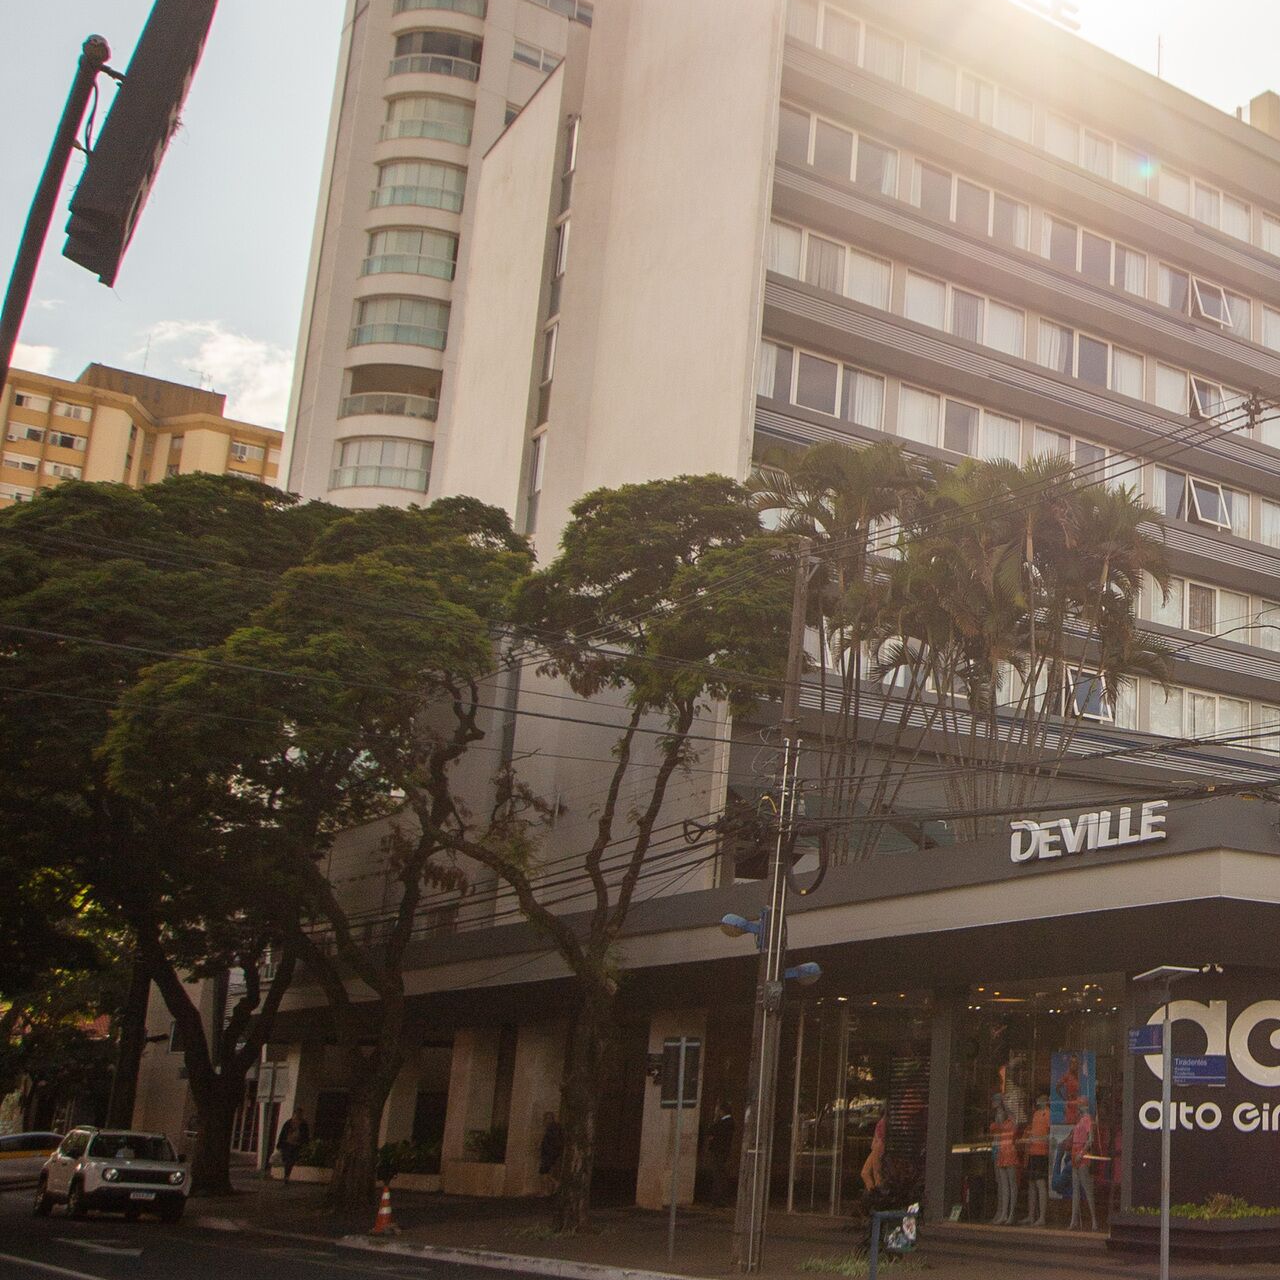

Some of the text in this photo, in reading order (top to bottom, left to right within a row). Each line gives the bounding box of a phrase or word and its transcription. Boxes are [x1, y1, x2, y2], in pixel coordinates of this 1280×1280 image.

[1010, 799, 1169, 863] DEVILLE
[1174, 1058, 1208, 1067] Tiradentes
[1138, 1100, 1222, 1132] alto
